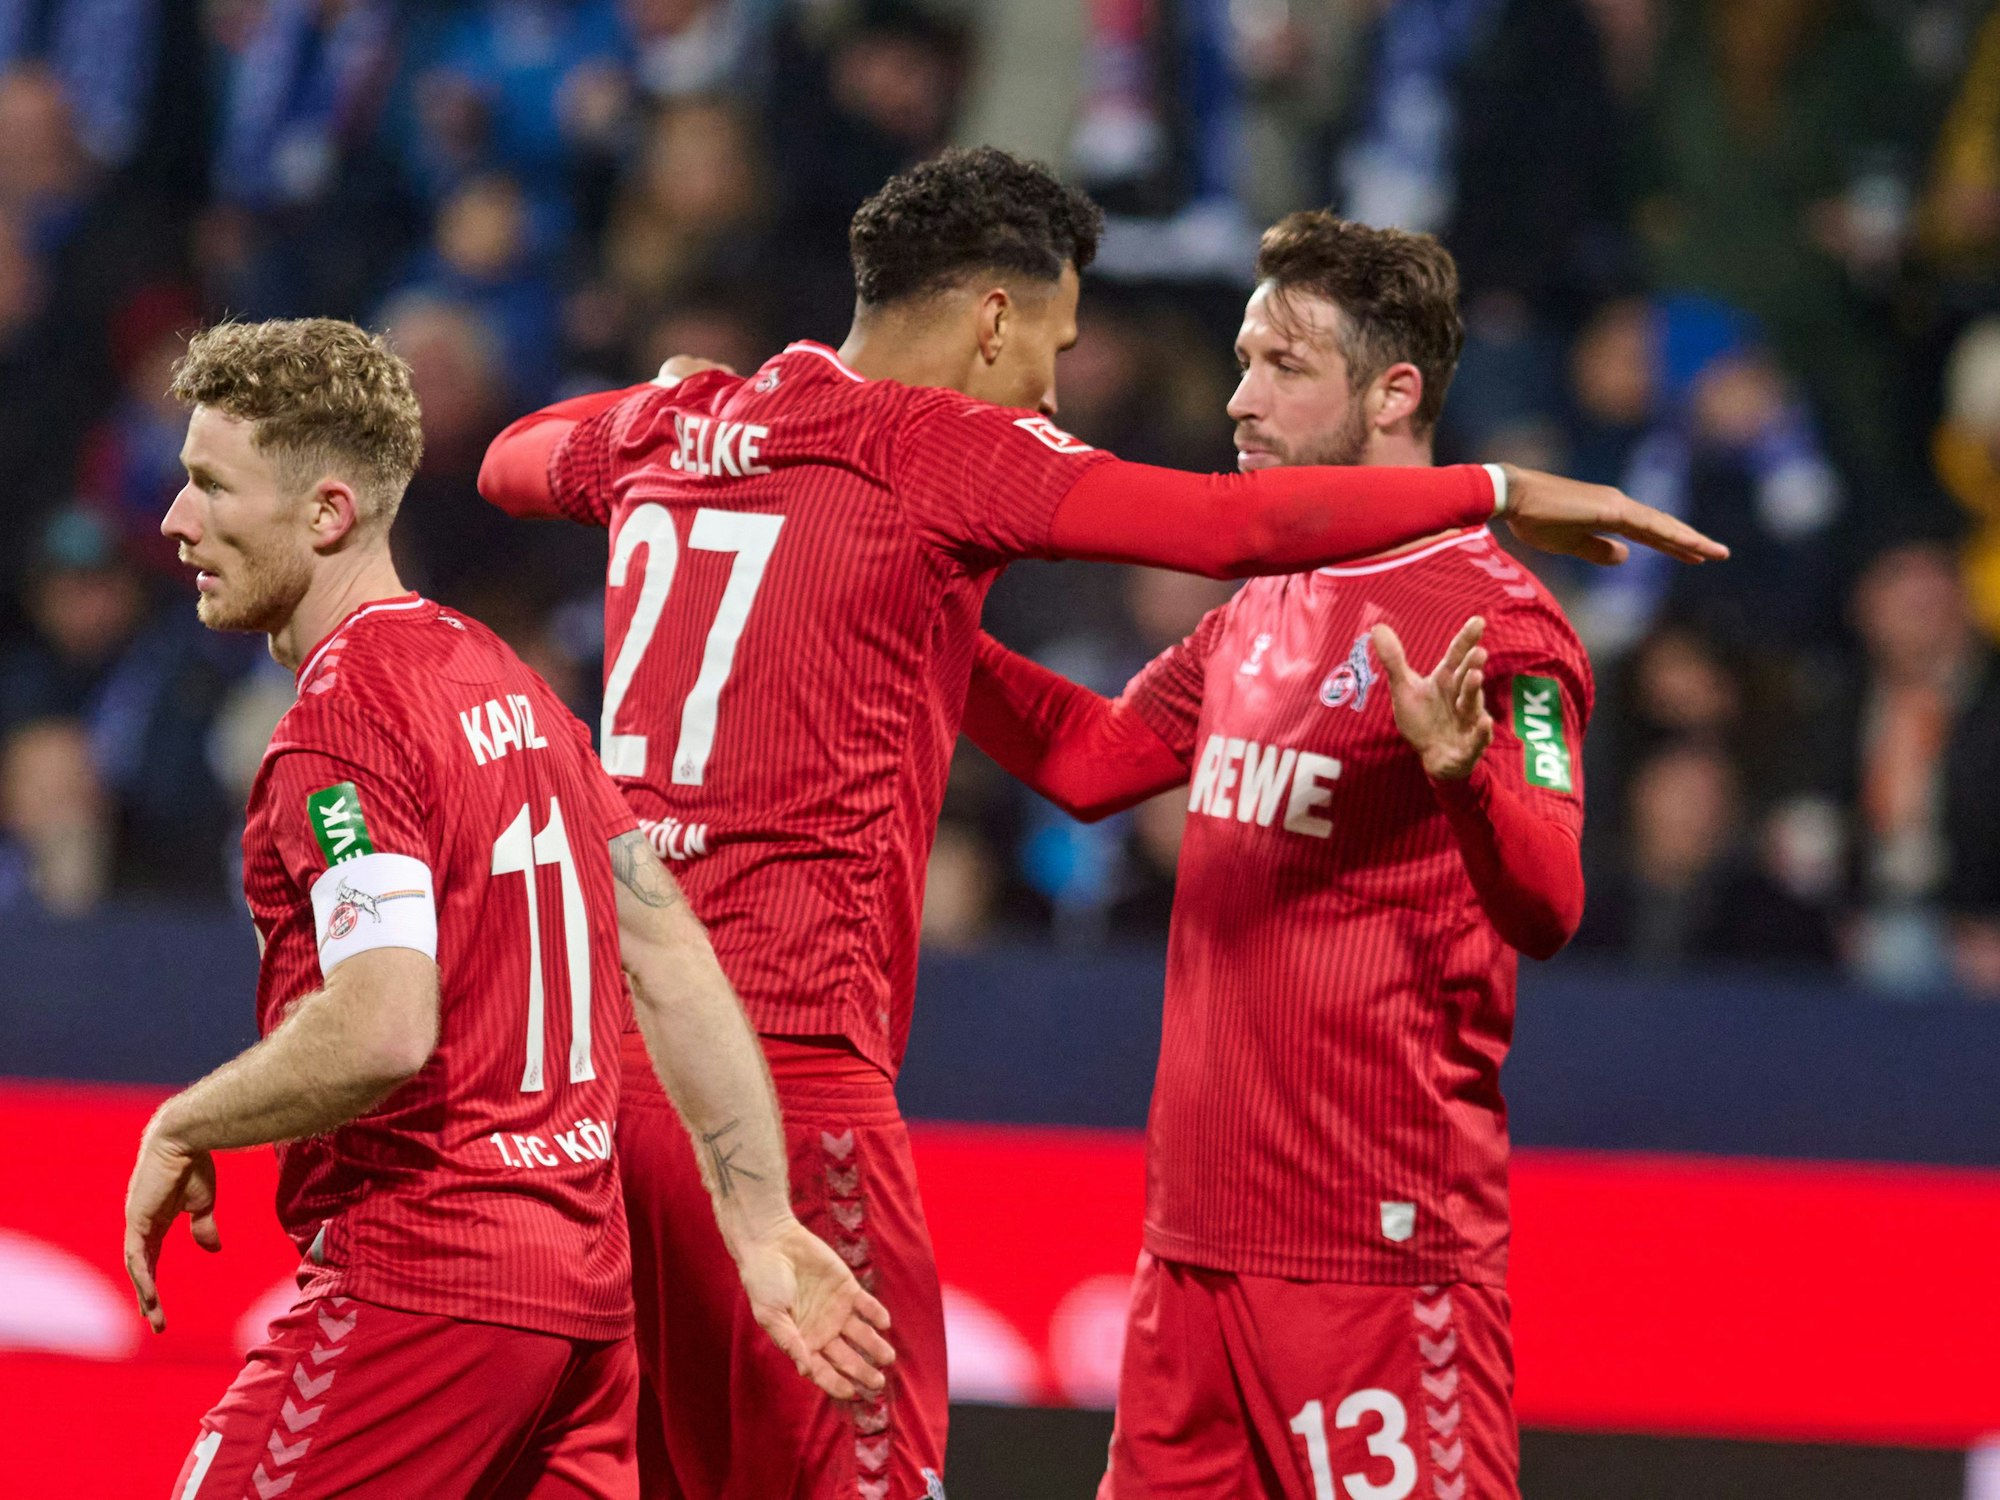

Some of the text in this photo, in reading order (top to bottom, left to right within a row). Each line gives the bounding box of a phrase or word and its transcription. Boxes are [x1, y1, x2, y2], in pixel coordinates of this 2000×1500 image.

[600, 502, 786, 786] 27
[1187, 733, 1342, 839] REWE
[491, 796, 596, 1092] 11
[489, 1132, 559, 1168] 1.FC
[1289, 1388, 1418, 1500] 13
